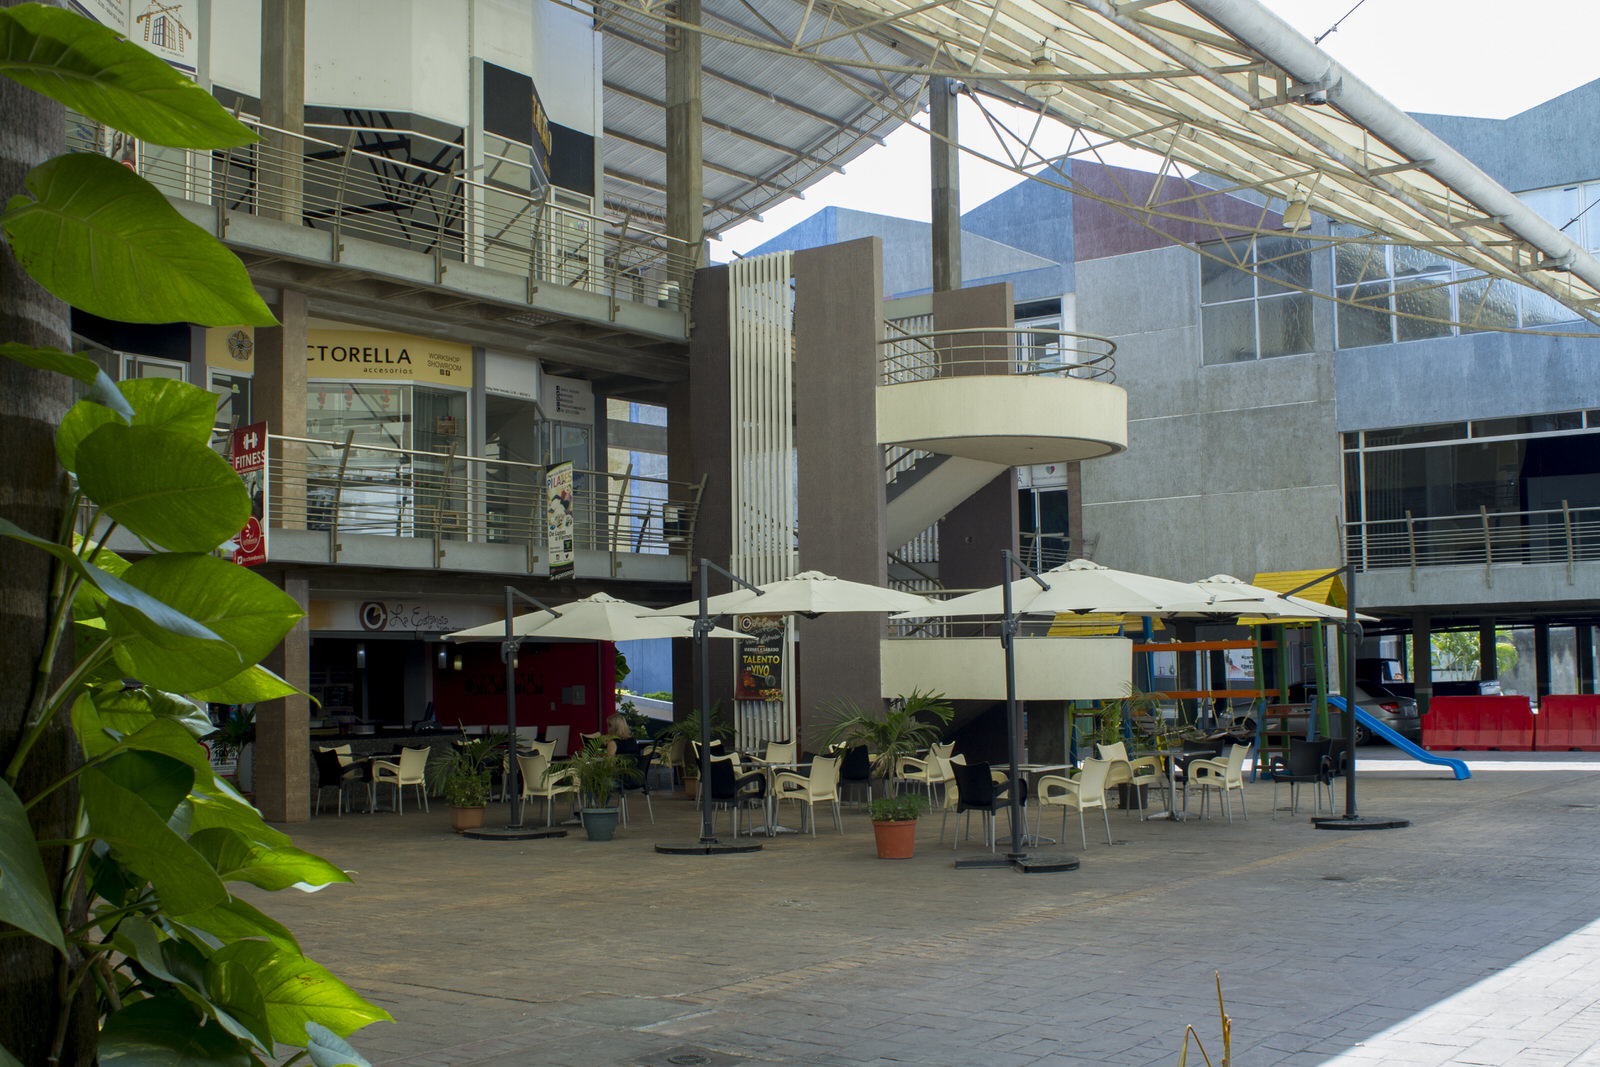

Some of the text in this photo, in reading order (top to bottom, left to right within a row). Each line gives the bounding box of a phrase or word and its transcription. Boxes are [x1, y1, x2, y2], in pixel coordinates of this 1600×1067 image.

[428, 352, 461, 363] WORKSHOP
[363, 367, 413, 375] accesorios
[427, 360, 462, 372] SHOWROOM
[235, 450, 265, 470] FITNESS
[547, 471, 573, 489] PILATES
[389, 603, 409, 628] La
[742, 655, 780, 664] TALENTO
[751, 665, 770, 677] VIVO
